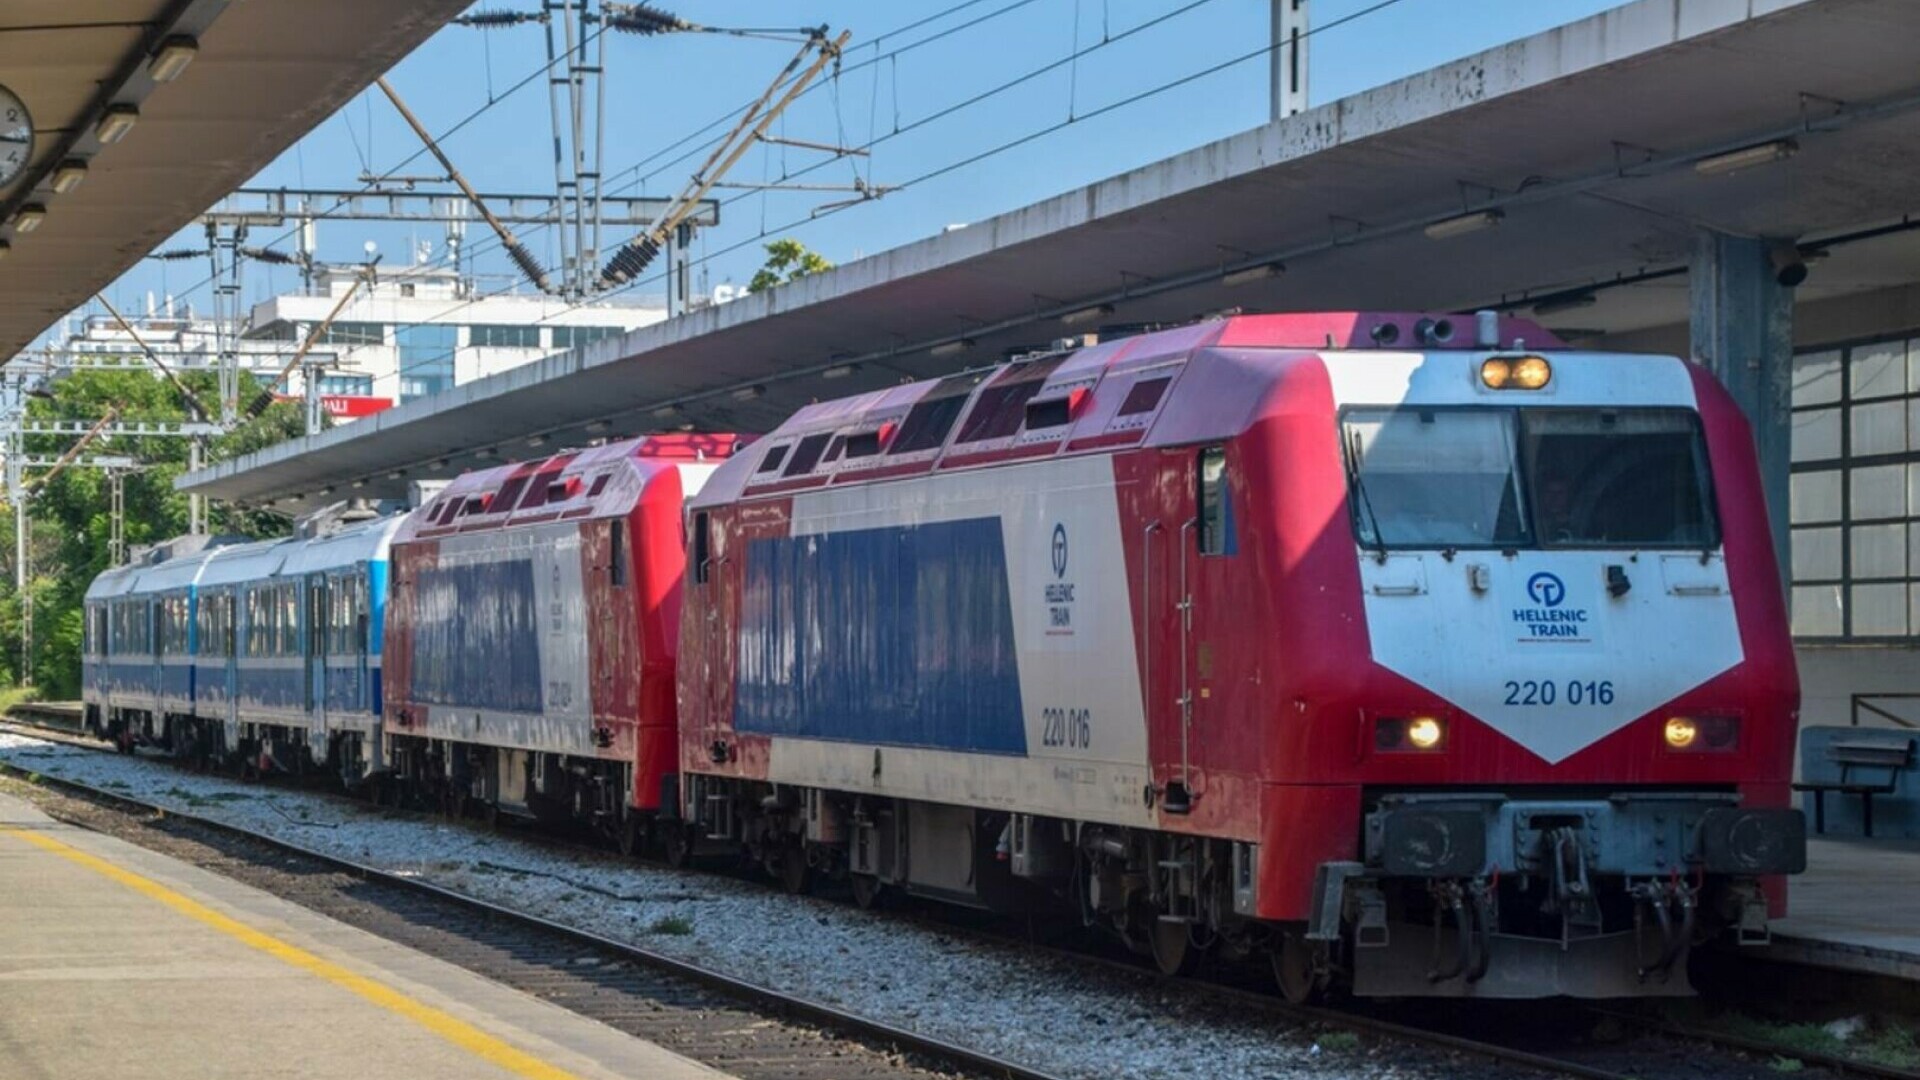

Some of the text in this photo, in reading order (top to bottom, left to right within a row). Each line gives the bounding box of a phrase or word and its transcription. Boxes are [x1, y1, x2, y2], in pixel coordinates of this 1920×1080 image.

[1512, 609, 1588, 622] HELLENIC
[1528, 624, 1578, 637] TRAIN
[1504, 680, 1614, 705] 220 016
[1043, 707, 1091, 749] 220 016
